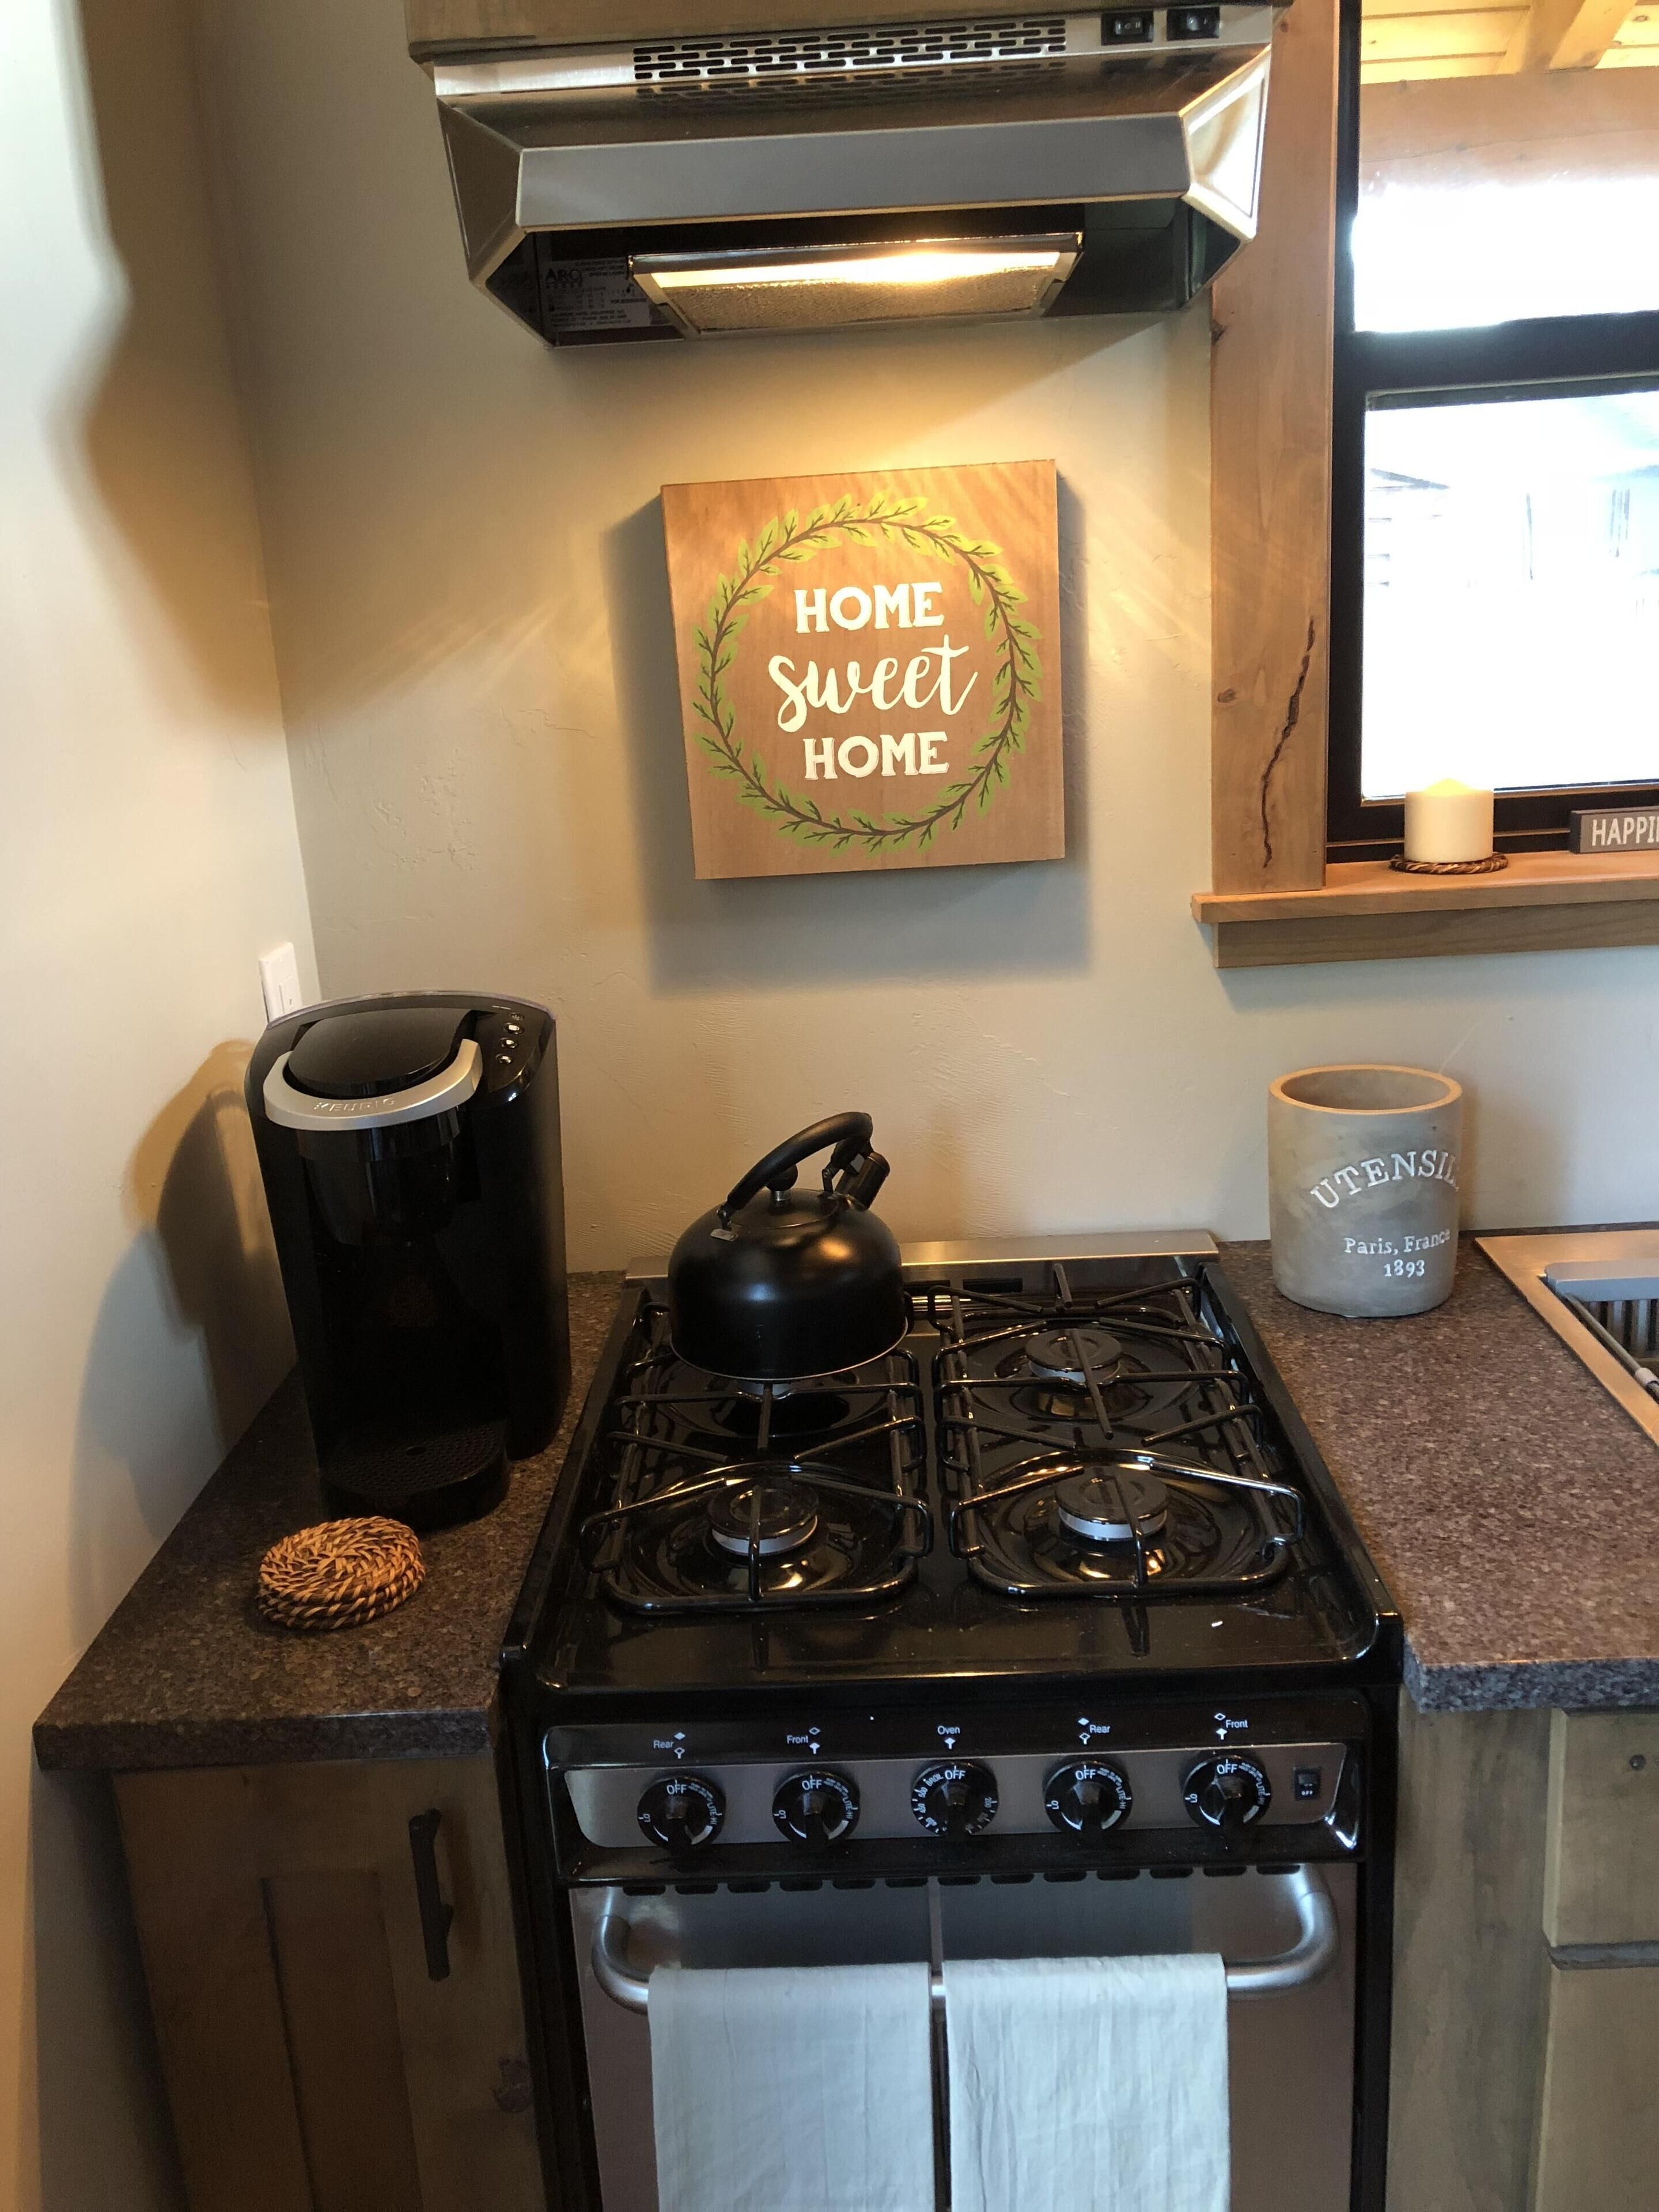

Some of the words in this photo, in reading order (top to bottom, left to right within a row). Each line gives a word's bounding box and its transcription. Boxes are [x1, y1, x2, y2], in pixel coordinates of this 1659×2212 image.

[794, 581, 945, 633] HOME
[802, 731, 949, 780] HOME
[1592, 816, 1659, 846] HAPPI
[314, 1098, 395, 1111] KEURIG
[1310, 1150, 1459, 1208] UTENSIL
[1344, 1237, 1399, 1255] Paris,
[1403, 1229, 1450, 1253] France
[1384, 1259, 1425, 1278] 1893
[1089, 1724, 1111, 1733] Rear
[1225, 1719, 1249, 1728] Front
[937, 1725, 961, 1734] Oven
[653, 1740, 674, 1749] Rear
[787, 1735, 809, 1744] Front
[1216, 1763, 1238, 1774] OFF
[945, 1770, 966, 1780] OFF
[1075, 1770, 1096, 1780] OFF
[666, 1784, 687, 1794] OFF
[801, 1779, 823, 1790] OFF
[1190, 1793, 1198, 1803] LO
[1051, 1800, 1059, 1810] LO
